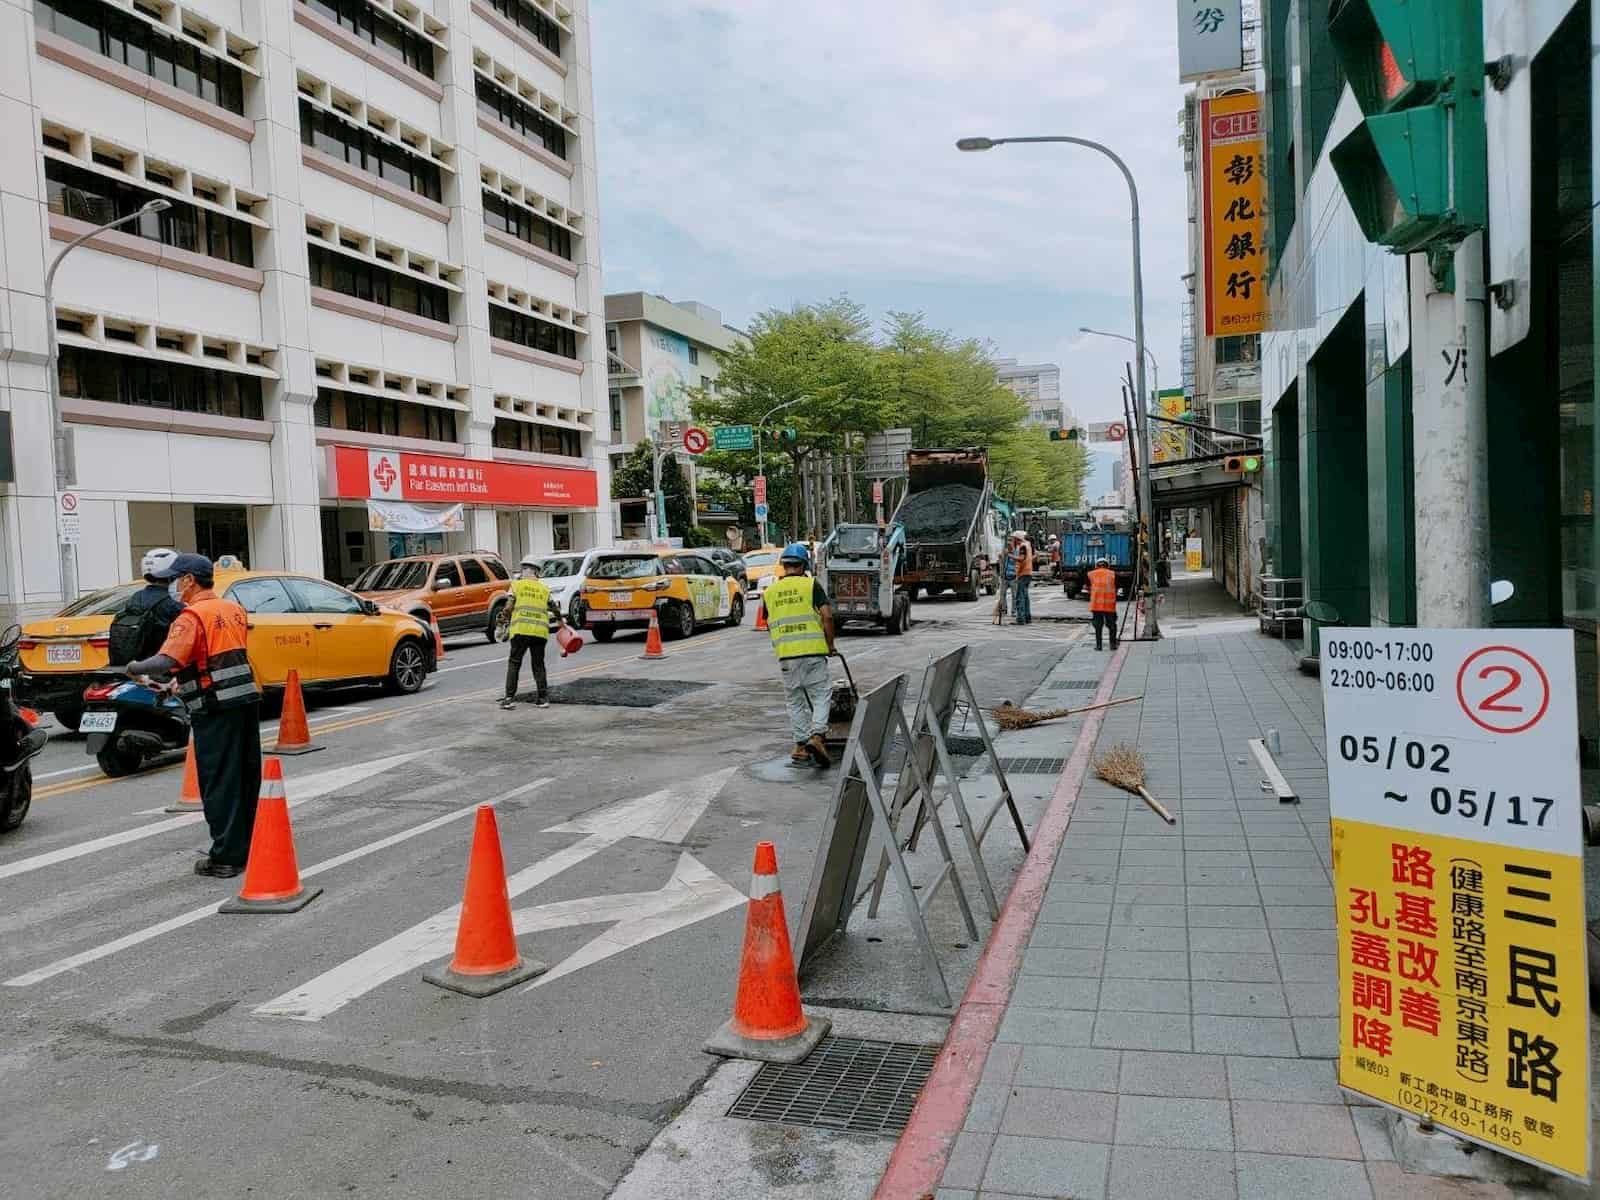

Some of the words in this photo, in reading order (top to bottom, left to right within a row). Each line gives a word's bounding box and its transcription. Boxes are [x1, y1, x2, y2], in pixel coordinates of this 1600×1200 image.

[1224, 154, 1257, 300] 彰化銀行
[409, 479, 425, 490] Far
[425, 480, 455, 493] Eastern
[469, 482, 489, 494] Bank
[1328, 640, 1434, 663] 09:00~17:00
[1330, 669, 1436, 693] 22:00~06:00
[1340, 734, 1451, 774] 05/02
[1430, 786, 1554, 827] 05/17
[1391, 842, 1442, 1038] 路基改善
[1348, 886, 1394, 1058] 孔蓋調降
[1449, 857, 1489, 1084] (健康路至南京東路)
[1503, 862, 1563, 1103] 三民路
[1398, 1088, 1523, 1147] (02)2749-1495
